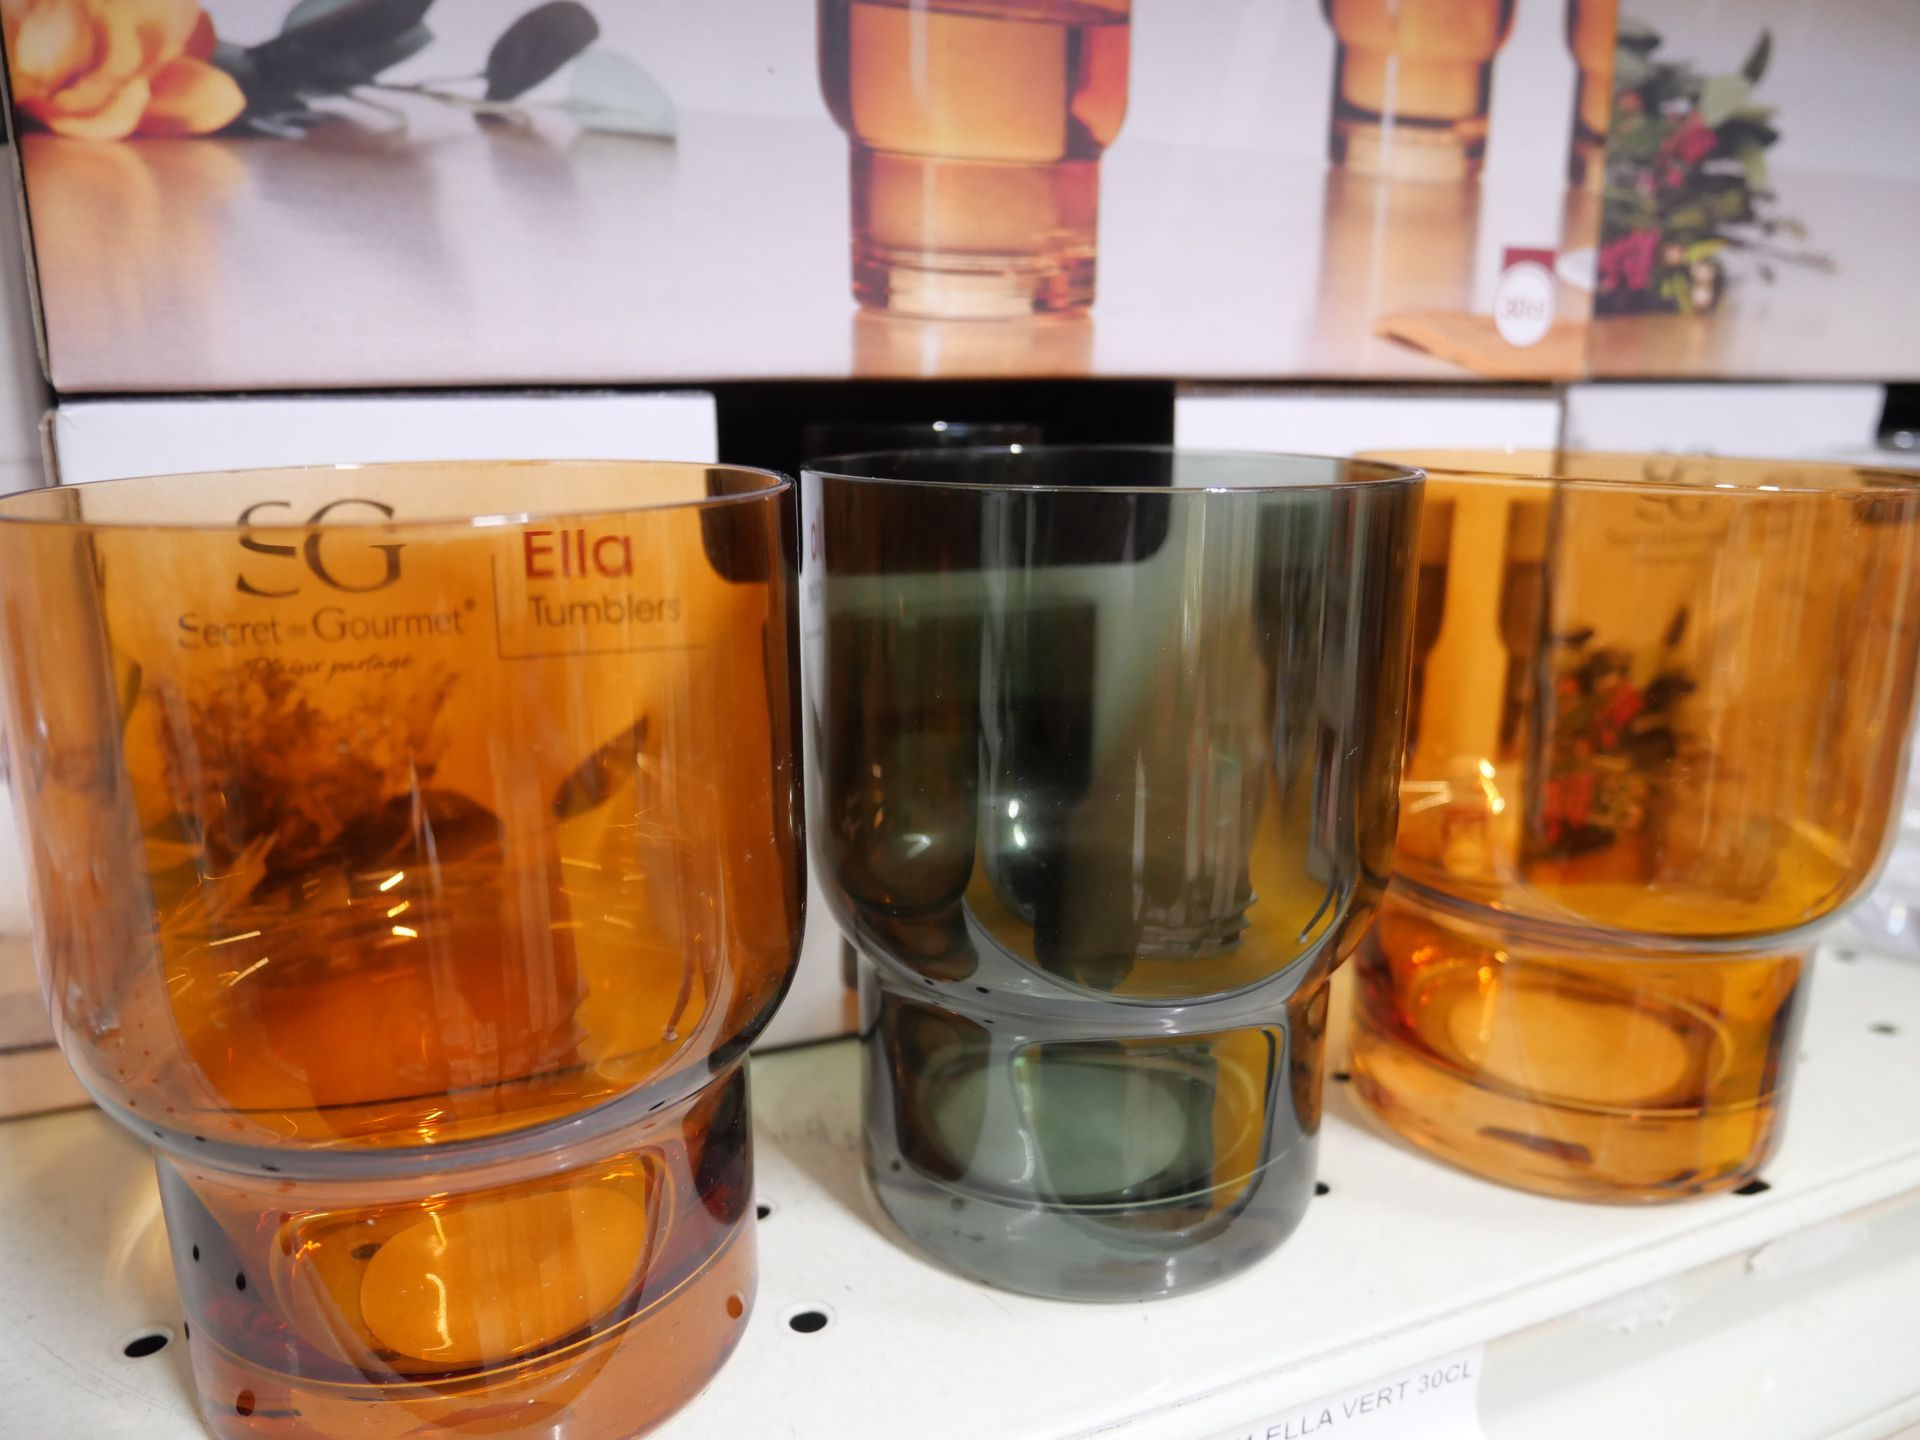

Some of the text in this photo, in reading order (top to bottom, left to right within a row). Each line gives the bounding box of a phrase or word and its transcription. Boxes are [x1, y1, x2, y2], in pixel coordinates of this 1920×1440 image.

[236, 498, 406, 598] SG
[524, 529, 634, 579] Ella
[178, 612, 282, 650] Secret
[528, 594, 681, 627] Tumblers
[1266, 1360, 1472, 1440] ELLA VERT 30CL
